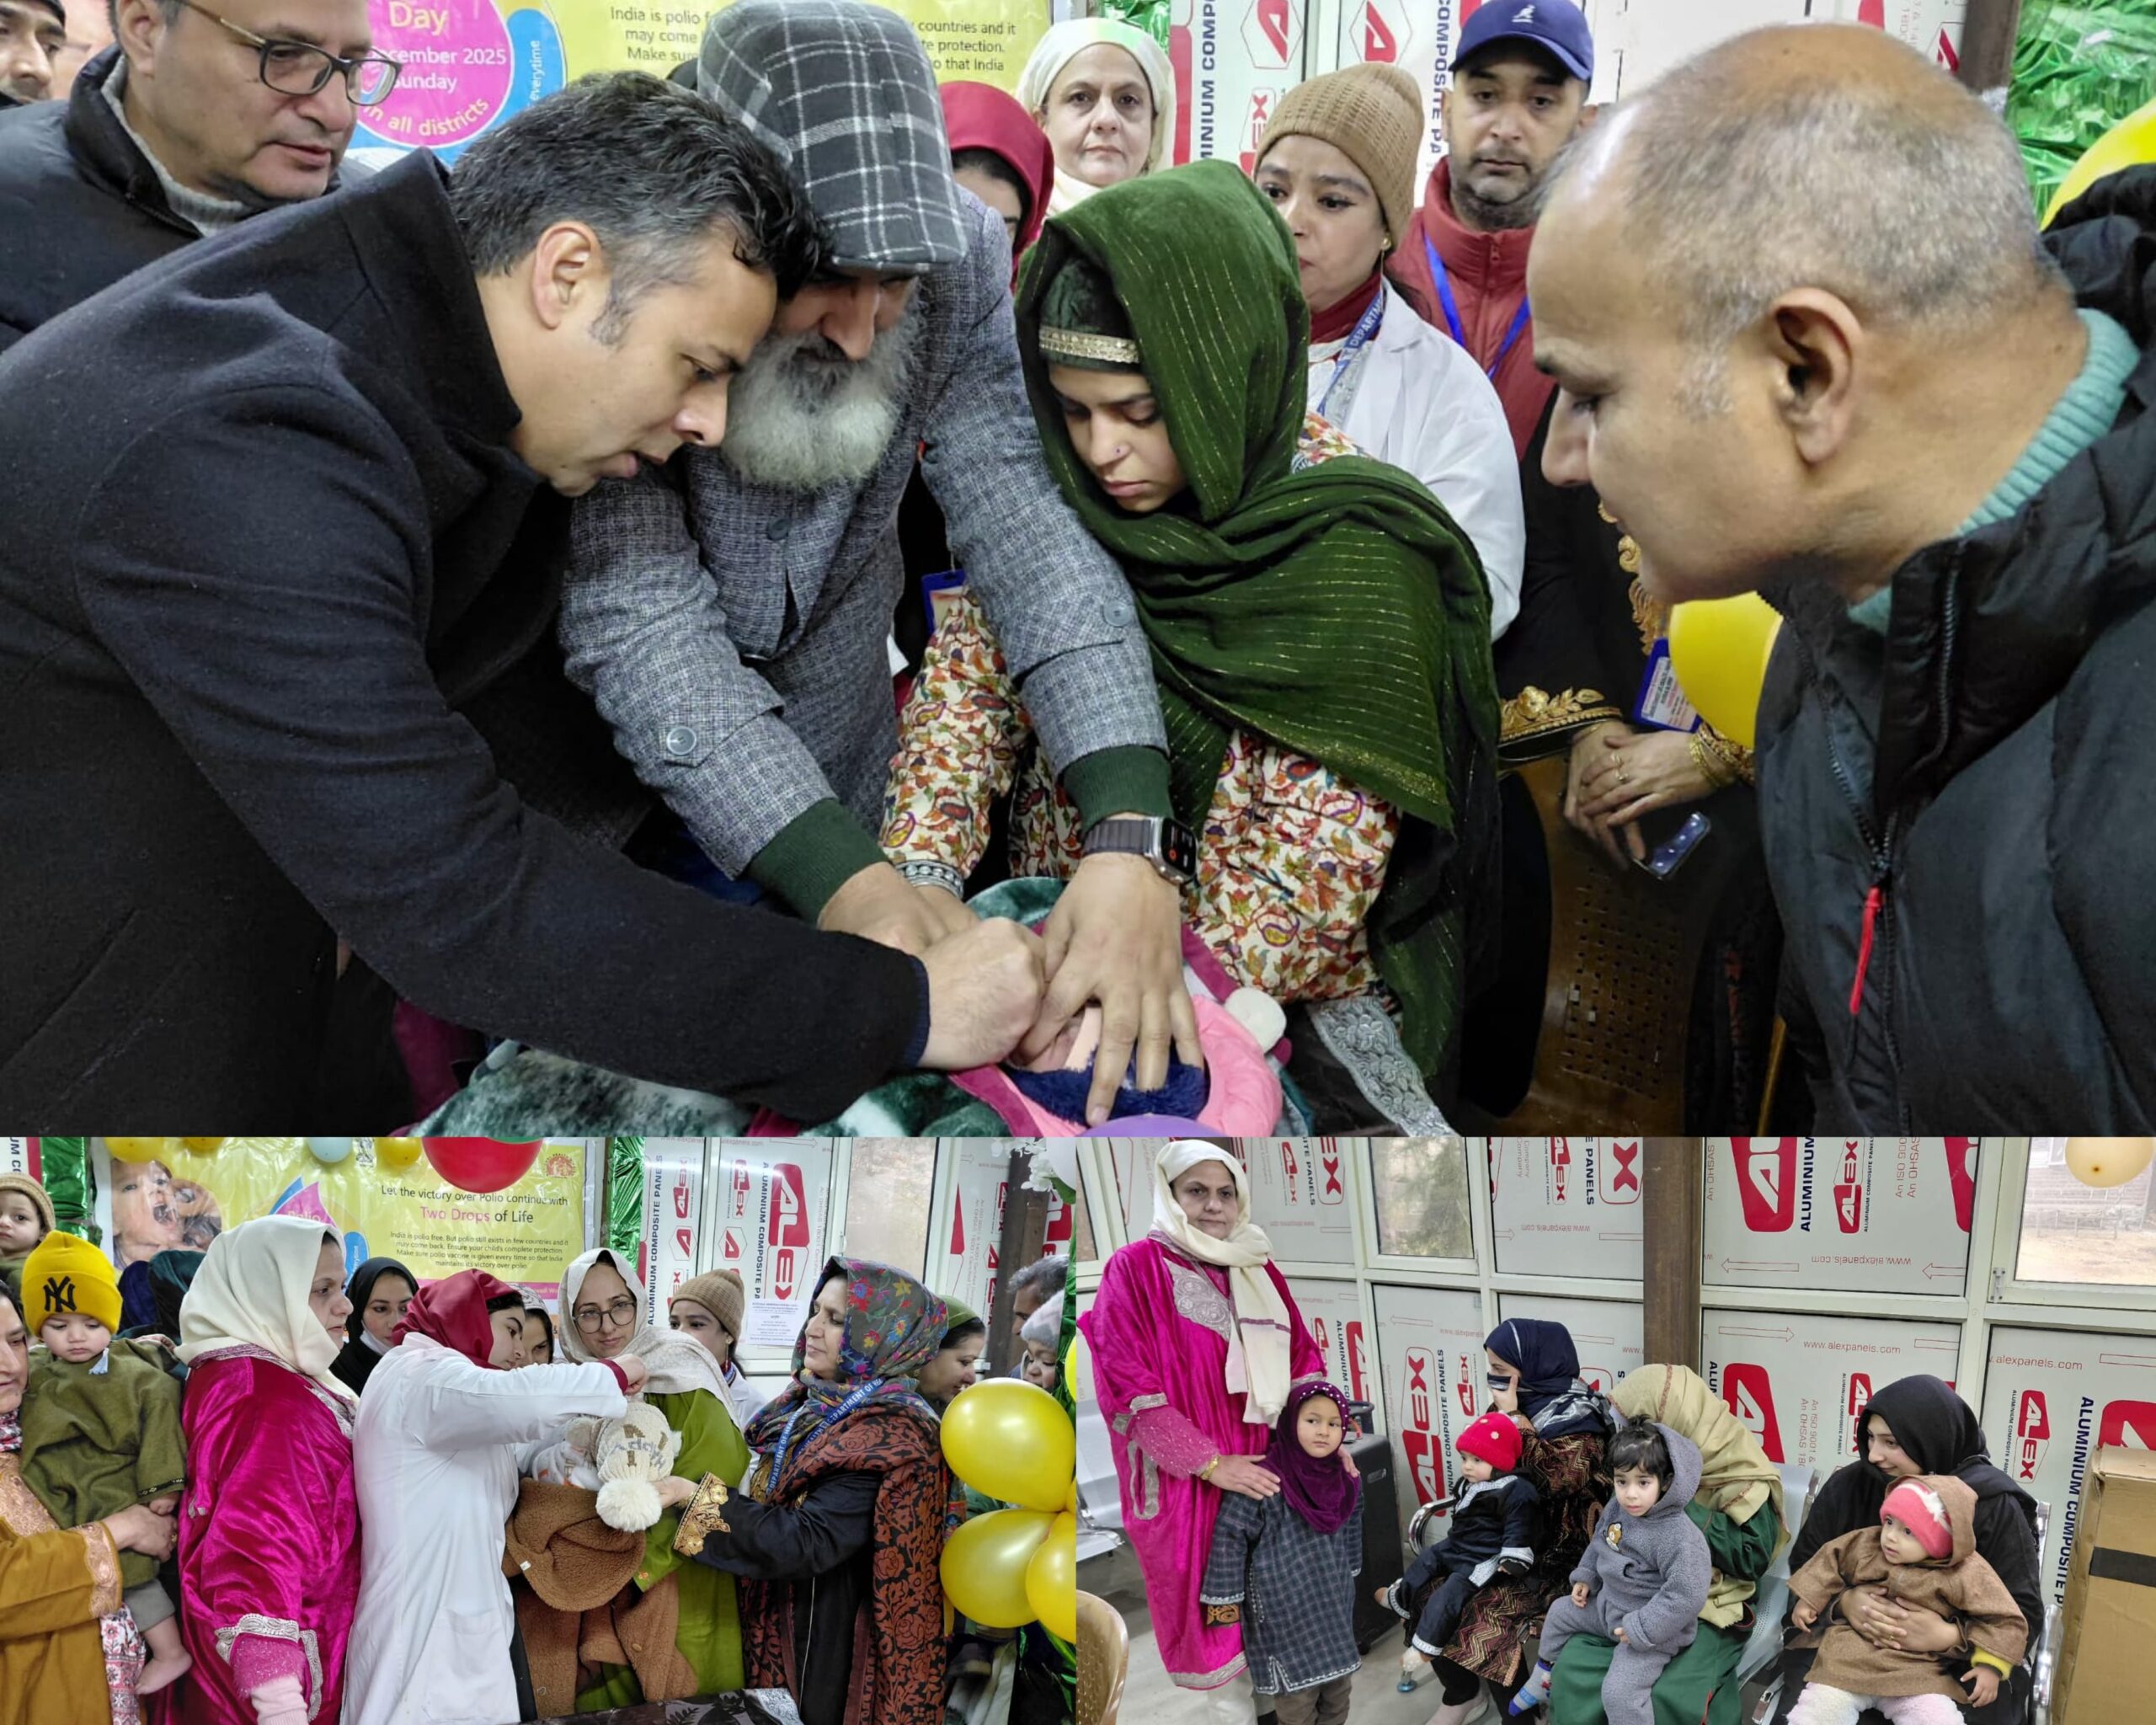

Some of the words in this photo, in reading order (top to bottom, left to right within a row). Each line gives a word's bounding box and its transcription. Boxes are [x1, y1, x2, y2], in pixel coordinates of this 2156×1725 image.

[389, 1, 448, 35] Day
[611, 7, 646, 21] India
[651, 8, 661, 21] is
[665, 10, 701, 28] polio
[918, 21, 977, 33] countries
[981, 22, 1001, 34] and
[1007, 23, 1016, 35] it
[626, 29, 654, 42] may
[659, 31, 697, 43] come
[938, 40, 1004, 53] protection.
[464, 49, 506, 65] 2025
[530, 40, 545, 101] everytime
[627, 47, 666, 61] Make
[946, 58, 969, 70] that
[974, 59, 1004, 71] India
[388, 116, 412, 133] all
[419, 99, 489, 136] districts
[1586, 1148, 1594, 1205] PANELS
[1706, 1145, 1715, 1183] OHSAS
[1897, 1162, 1906, 1183] ISO
[382, 1185, 398, 1195] Let
[400, 1187, 415, 1197] the
[418, 1188, 451, 1202] victory
[455, 1194, 476, 1202] over
[479, 1194, 504, 1203] Polio
[507, 1195, 547, 1204] continue
[549, 1197, 568, 1206] with
[1306, 1162, 1315, 1205] PANELS
[1706, 1187, 1714, 1201] An
[1838, 1141, 1860, 1229] ALEX
[1896, 1184, 1904, 1198] An
[1907, 1183, 1918, 1198] An
[420, 1206, 446, 1219] Two
[451, 1209, 490, 1223] Drops
[494, 1210, 508, 1222] of
[511, 1211, 533, 1223] Life
[651, 1201, 660, 1262] COMPOSITE
[755, 1226, 765, 1284] COMPOSITE
[647, 1265, 658, 1325] ALUMINIUM
[1337, 1321, 1348, 1381] ALUMINIUM
[1437, 1349, 1447, 1392] PANELS
[1801, 1398, 1809, 1411] An
[1812, 1399, 1818, 1410] An
[2009, 1390, 2017, 1424] ALUMINIUM
[1441, 1397, 1452, 1457] COMPOSITE
[1799, 1414, 1808, 1448] OHSAS
[1809, 1432, 1817, 1452] 9001
[2019, 1393, 2047, 1480] ALEX
[2069, 1397, 2095, 1495] ALUMINIUM
[769, 1446, 785, 1489] DEPARTMENT
